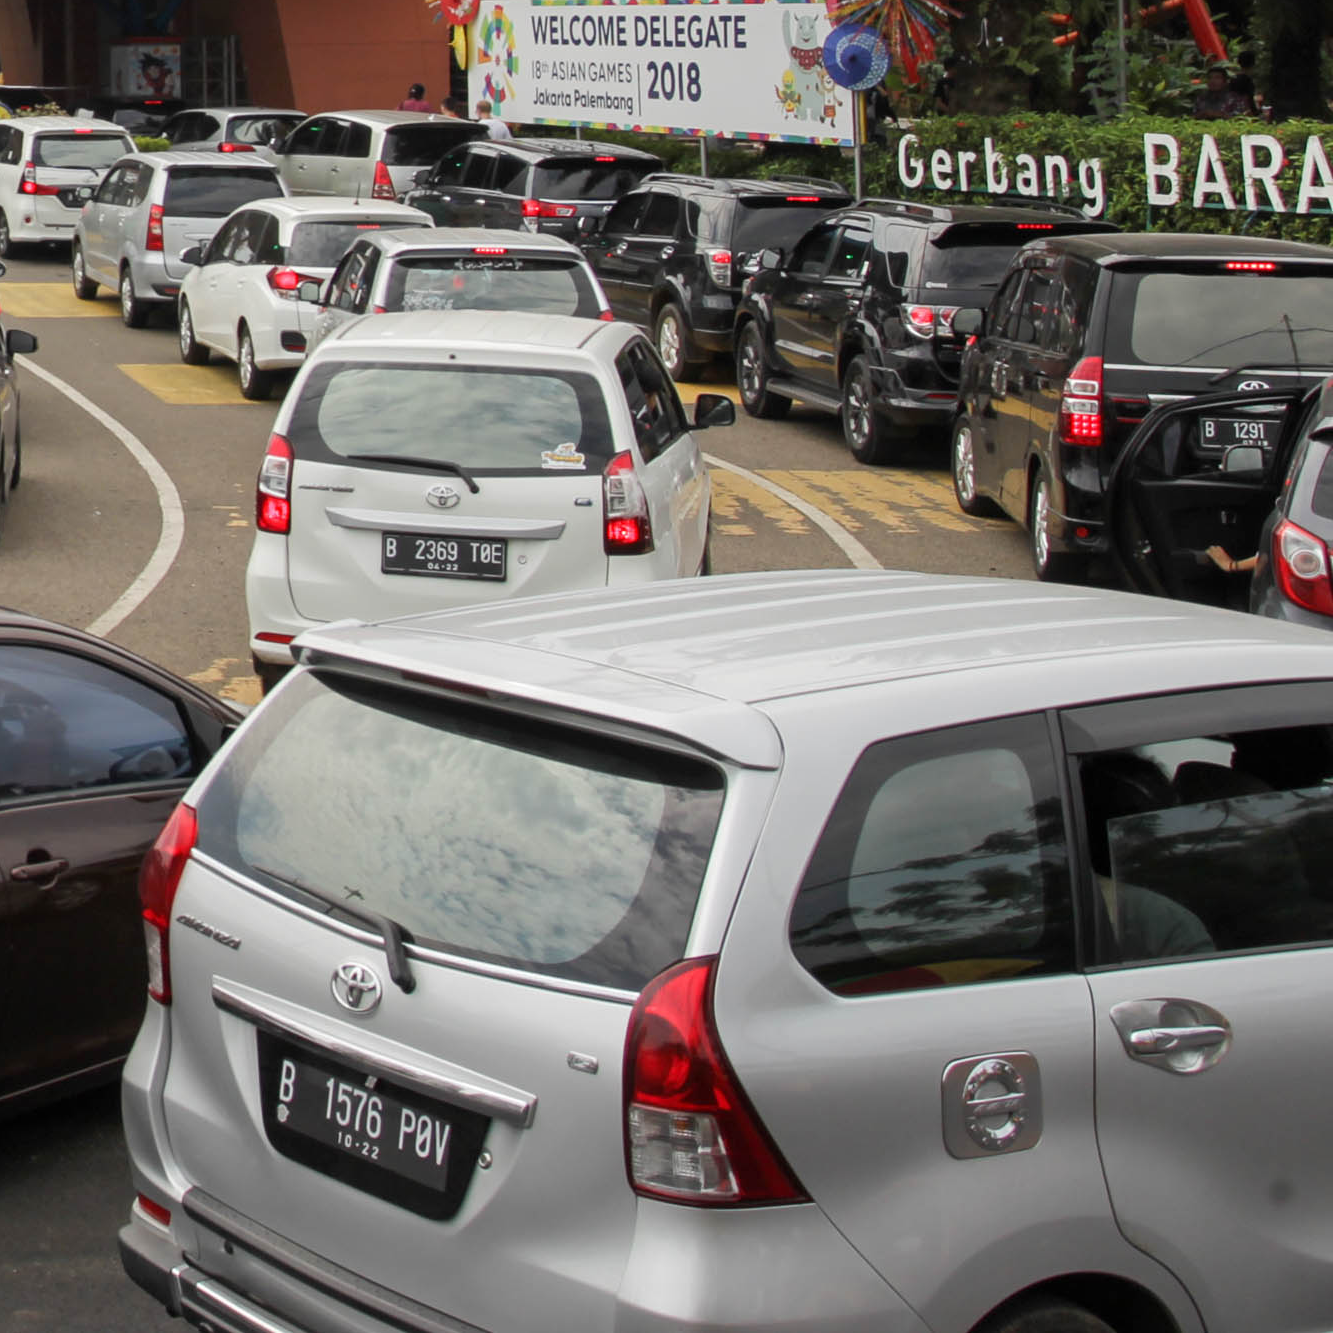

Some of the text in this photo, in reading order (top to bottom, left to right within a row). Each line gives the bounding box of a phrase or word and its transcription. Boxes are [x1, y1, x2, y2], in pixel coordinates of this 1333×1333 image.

[531, 14, 747, 49] WELCOME DELEGATE
[551, 60, 587, 82] ASIAN
[588, 62, 633, 84] GAMES
[646, 60, 702, 102] 2018
[533, 87, 634, 115] Jakarta Palembang
[898, 133, 1333, 218] Gerbang BARA
[1205, 421, 1264, 439] B 1291
[386, 537, 397, 558] B
[415, 539, 459, 561] 2369
[279, 1059, 296, 1103] B
[326, 1077, 383, 1138] 1576
